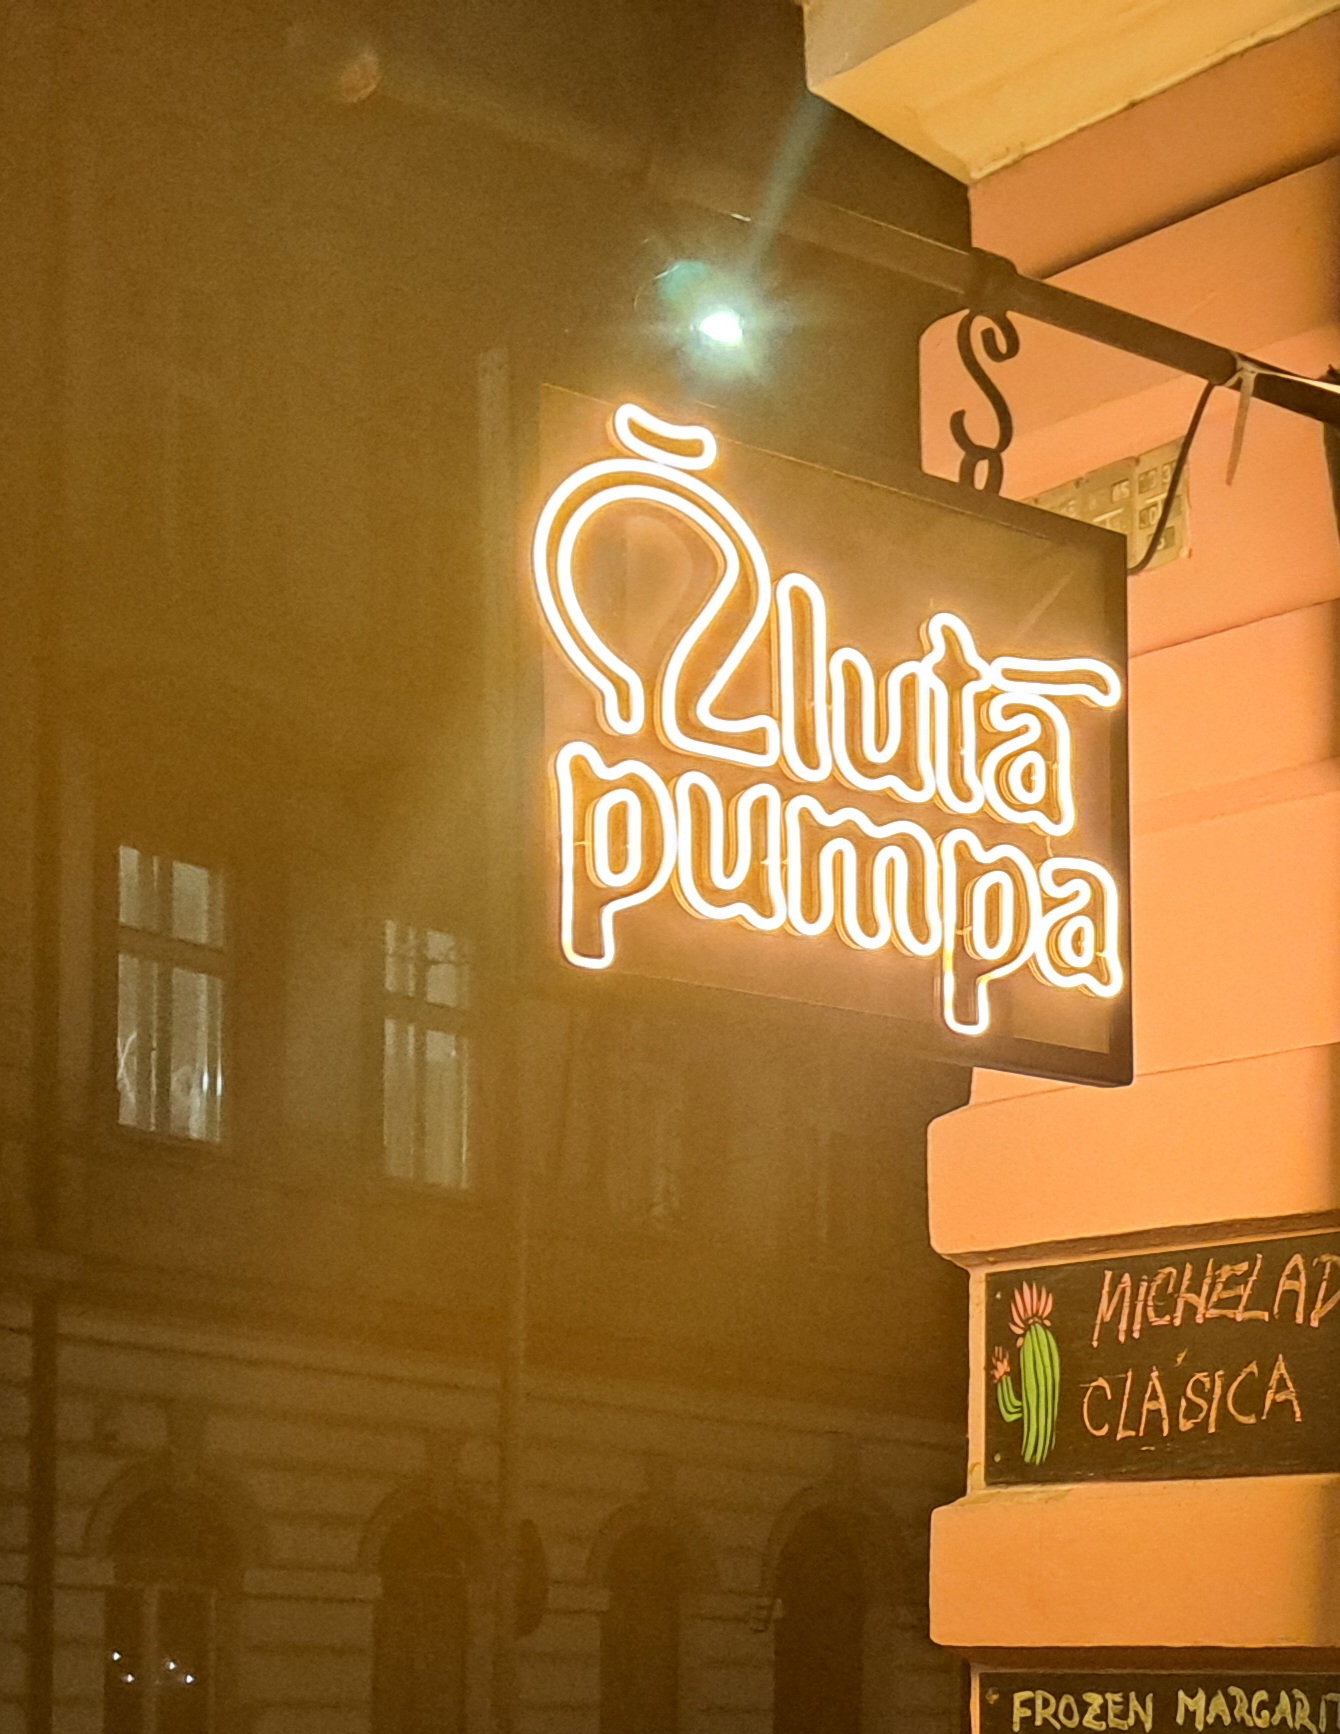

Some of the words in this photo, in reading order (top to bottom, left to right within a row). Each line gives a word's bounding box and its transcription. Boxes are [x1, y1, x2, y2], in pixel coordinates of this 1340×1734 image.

[556, 741, 1123, 1034] pumpa
[1081, 1348, 1302, 1441] CLÁSICA
[1012, 1689, 1154, 1733] FROZEN
